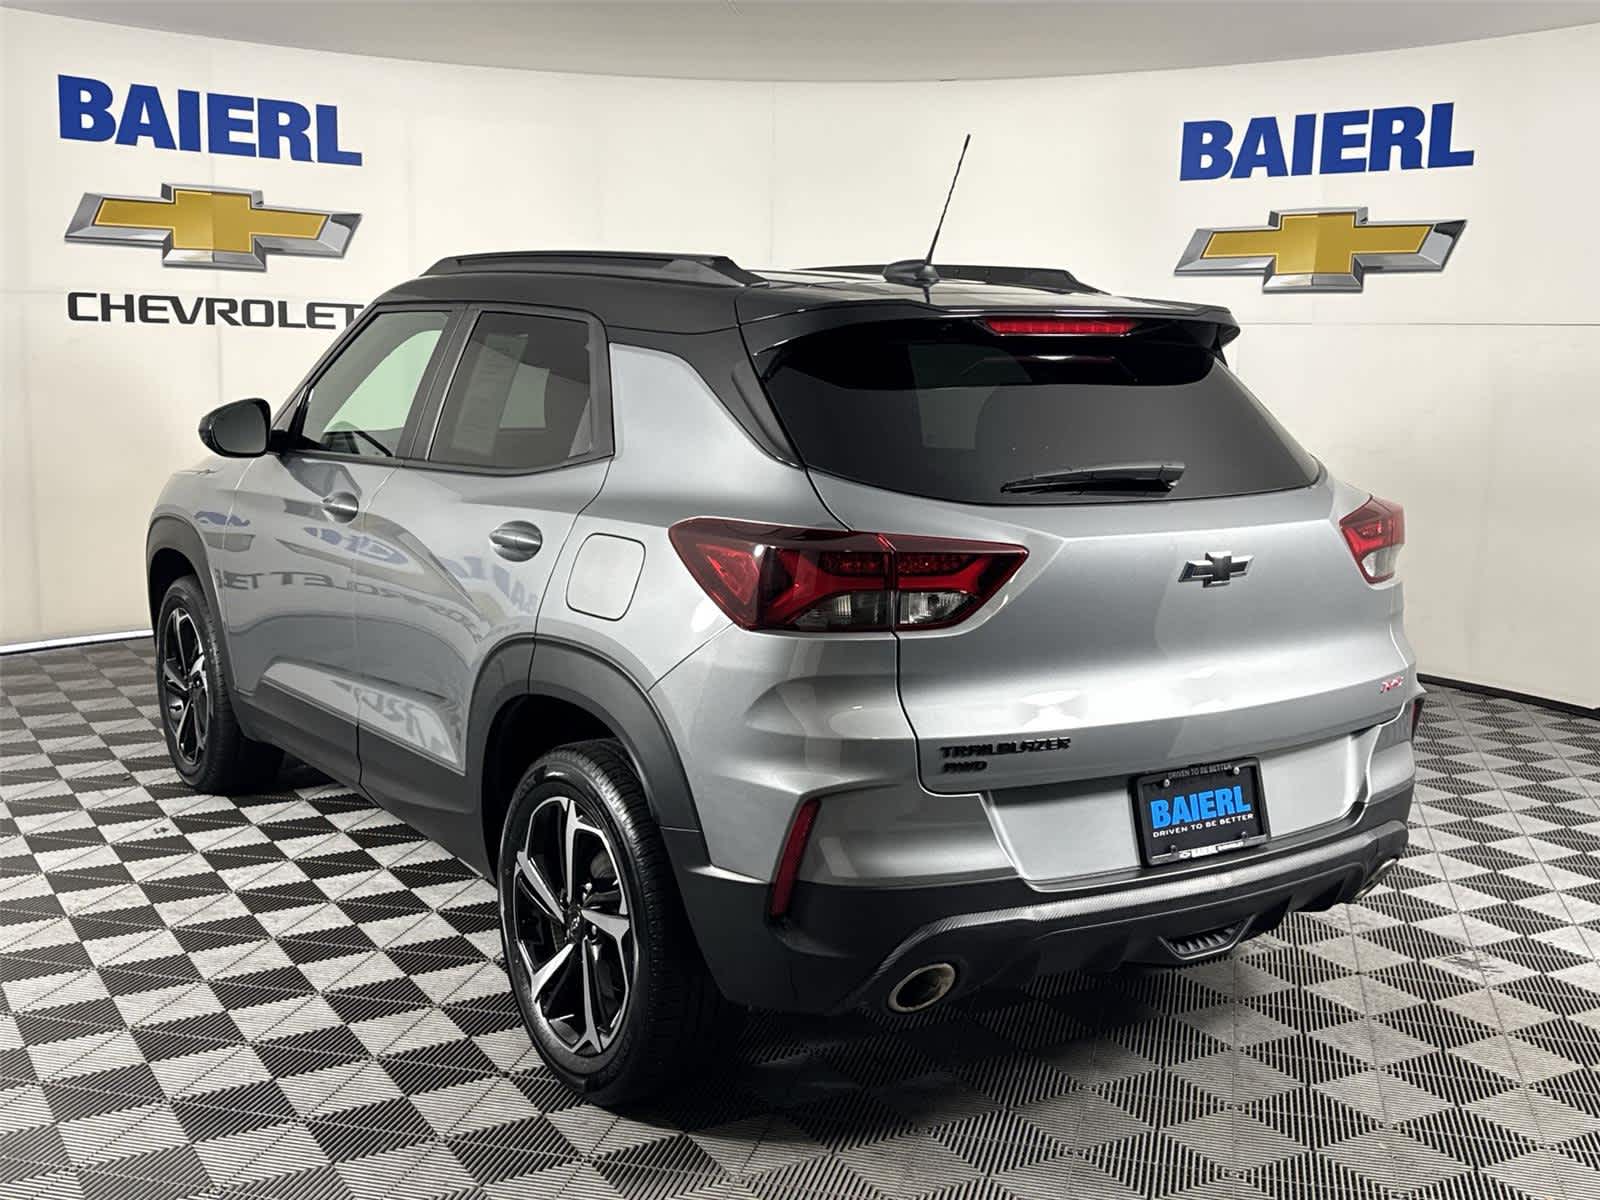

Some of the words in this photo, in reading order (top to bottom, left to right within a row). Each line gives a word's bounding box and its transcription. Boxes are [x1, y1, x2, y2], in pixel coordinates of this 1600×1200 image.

[58, 74, 362, 166] BAIERL
[1179, 102, 1474, 181] BAIERL
[67, 291, 365, 329] CHEVROLET
[939, 736, 1071, 758] TRAILBLAZER
[942, 760, 988, 773] AWD
[1150, 786, 1251, 829] BAIERL
[1152, 825, 1189, 838] DRIVEN
[1205, 820, 1217, 828] BE
[1219, 813, 1254, 825] BETTER
